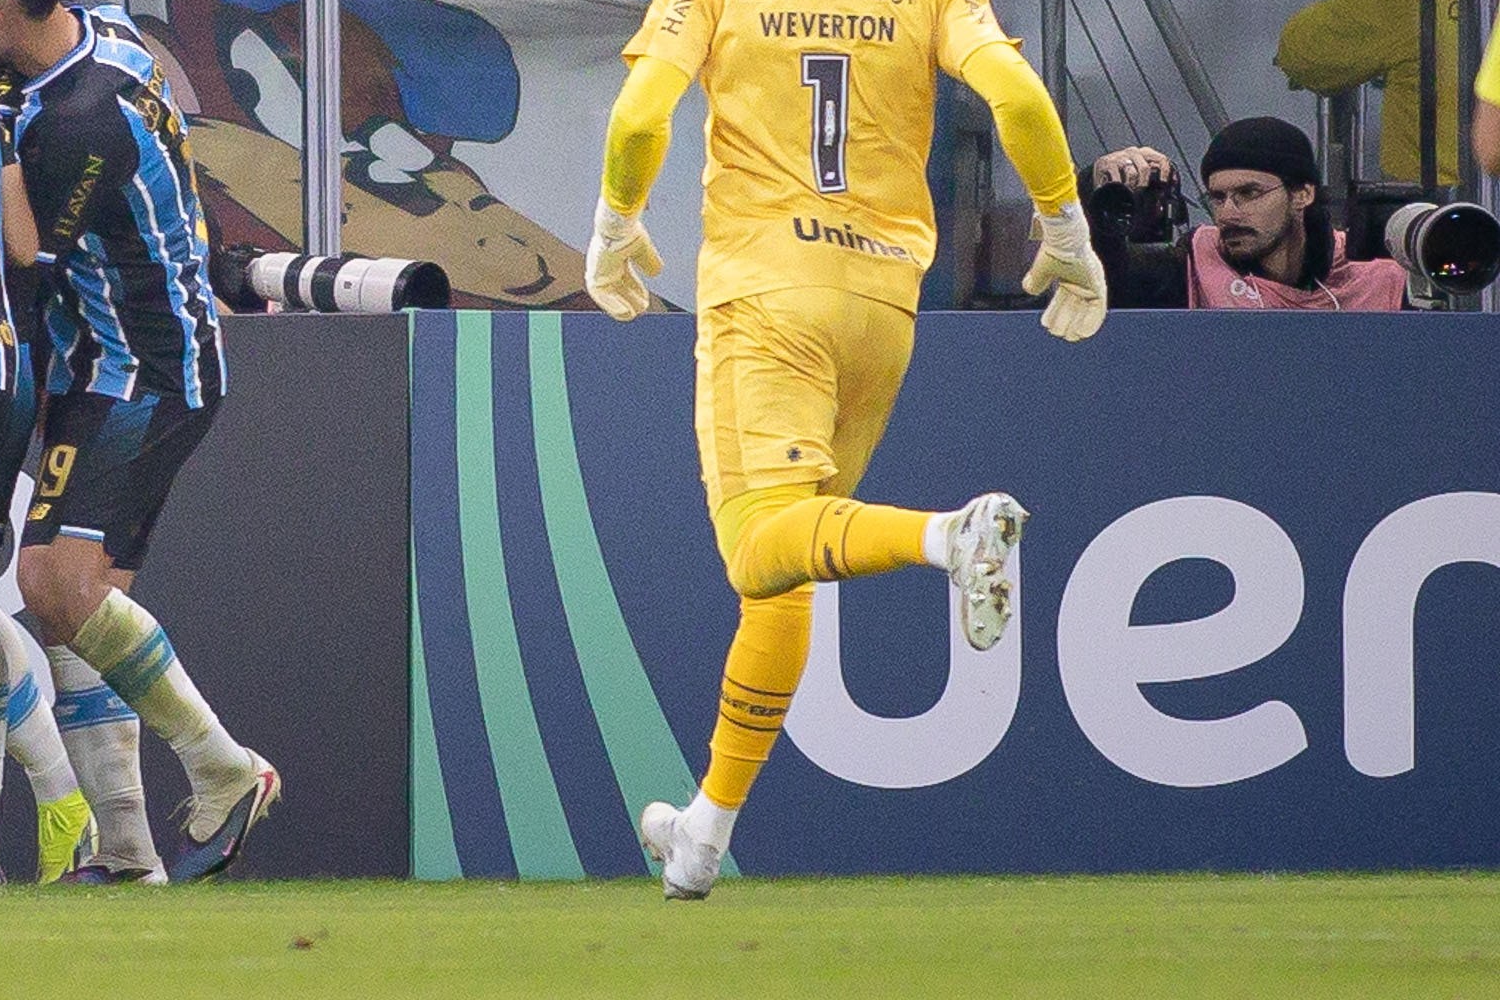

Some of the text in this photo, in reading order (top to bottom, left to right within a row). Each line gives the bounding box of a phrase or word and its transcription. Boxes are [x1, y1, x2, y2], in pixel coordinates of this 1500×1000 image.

[760, 11, 895, 42] WEVERTON
[801, 53, 851, 194] 1
[793, 217, 924, 270] Unime
